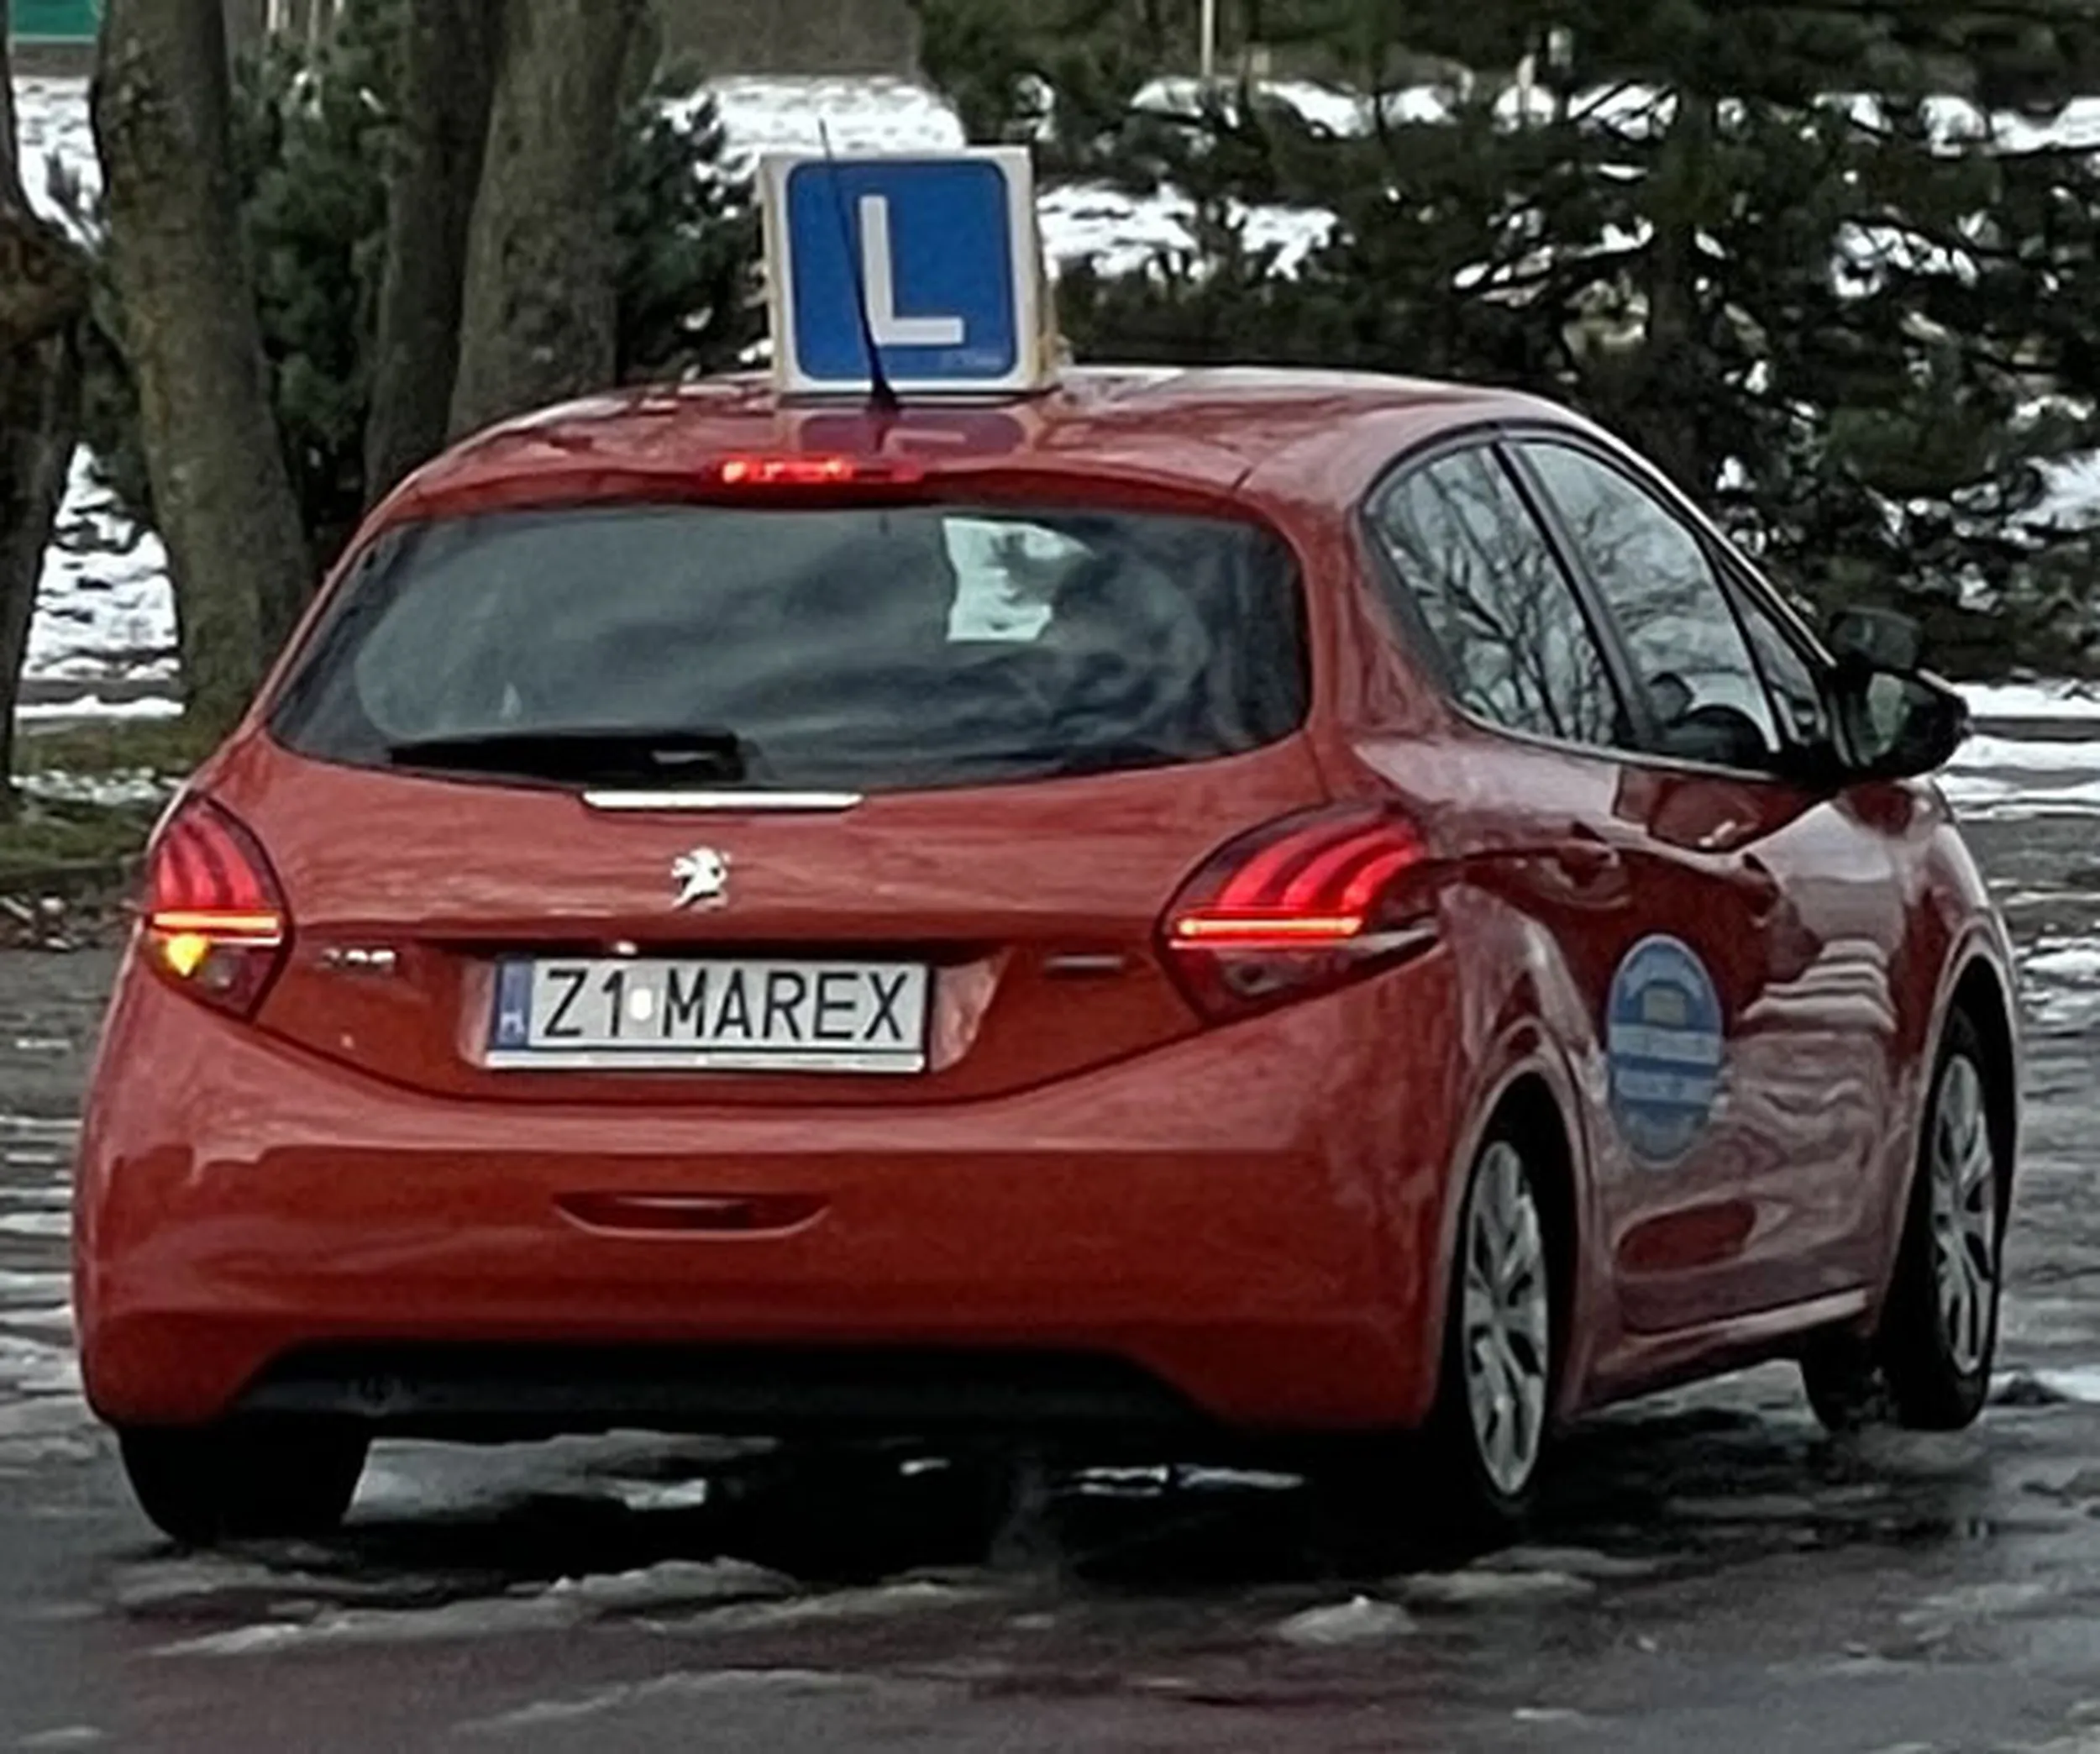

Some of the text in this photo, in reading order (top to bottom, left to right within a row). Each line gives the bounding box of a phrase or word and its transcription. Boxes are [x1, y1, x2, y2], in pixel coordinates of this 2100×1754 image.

[858, 194, 964, 346] L
[543, 968, 625, 1038] Z1
[661, 967, 909, 1041] MAREX
